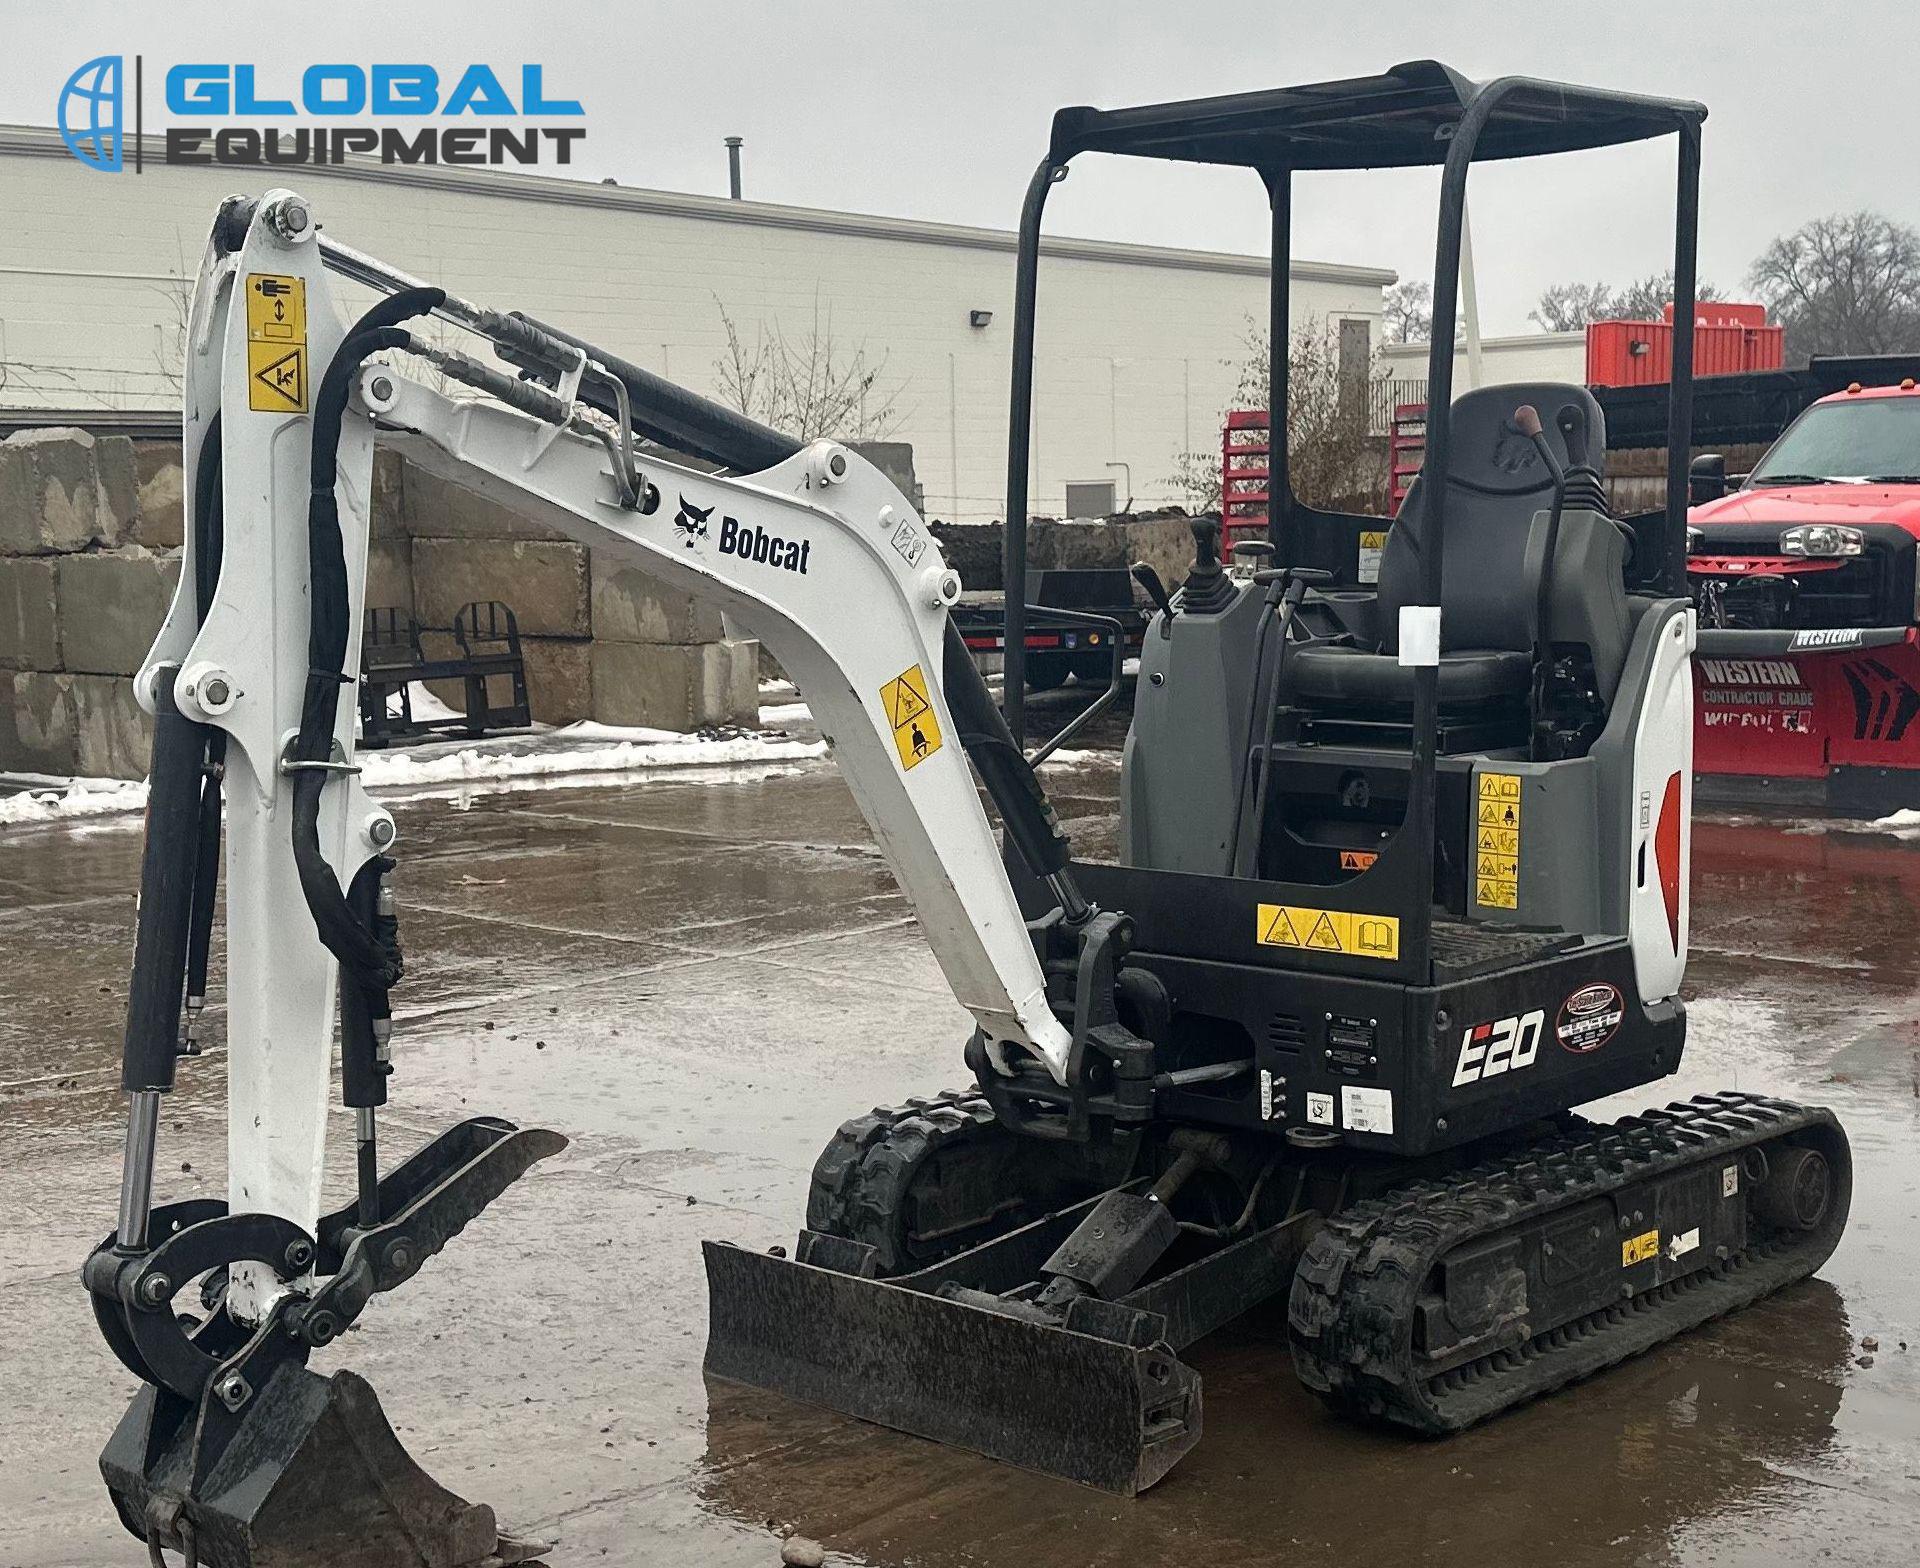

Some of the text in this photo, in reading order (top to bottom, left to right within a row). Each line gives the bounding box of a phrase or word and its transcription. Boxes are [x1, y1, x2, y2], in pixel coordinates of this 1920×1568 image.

[718, 515, 811, 575] Bobcat
[1797, 628, 1860, 646] WESTERN
[1700, 660, 1801, 685] WESTERN
[1702, 690, 1814, 707] CONTRACTOR GRADE
[1450, 1008, 1546, 1089] E20
